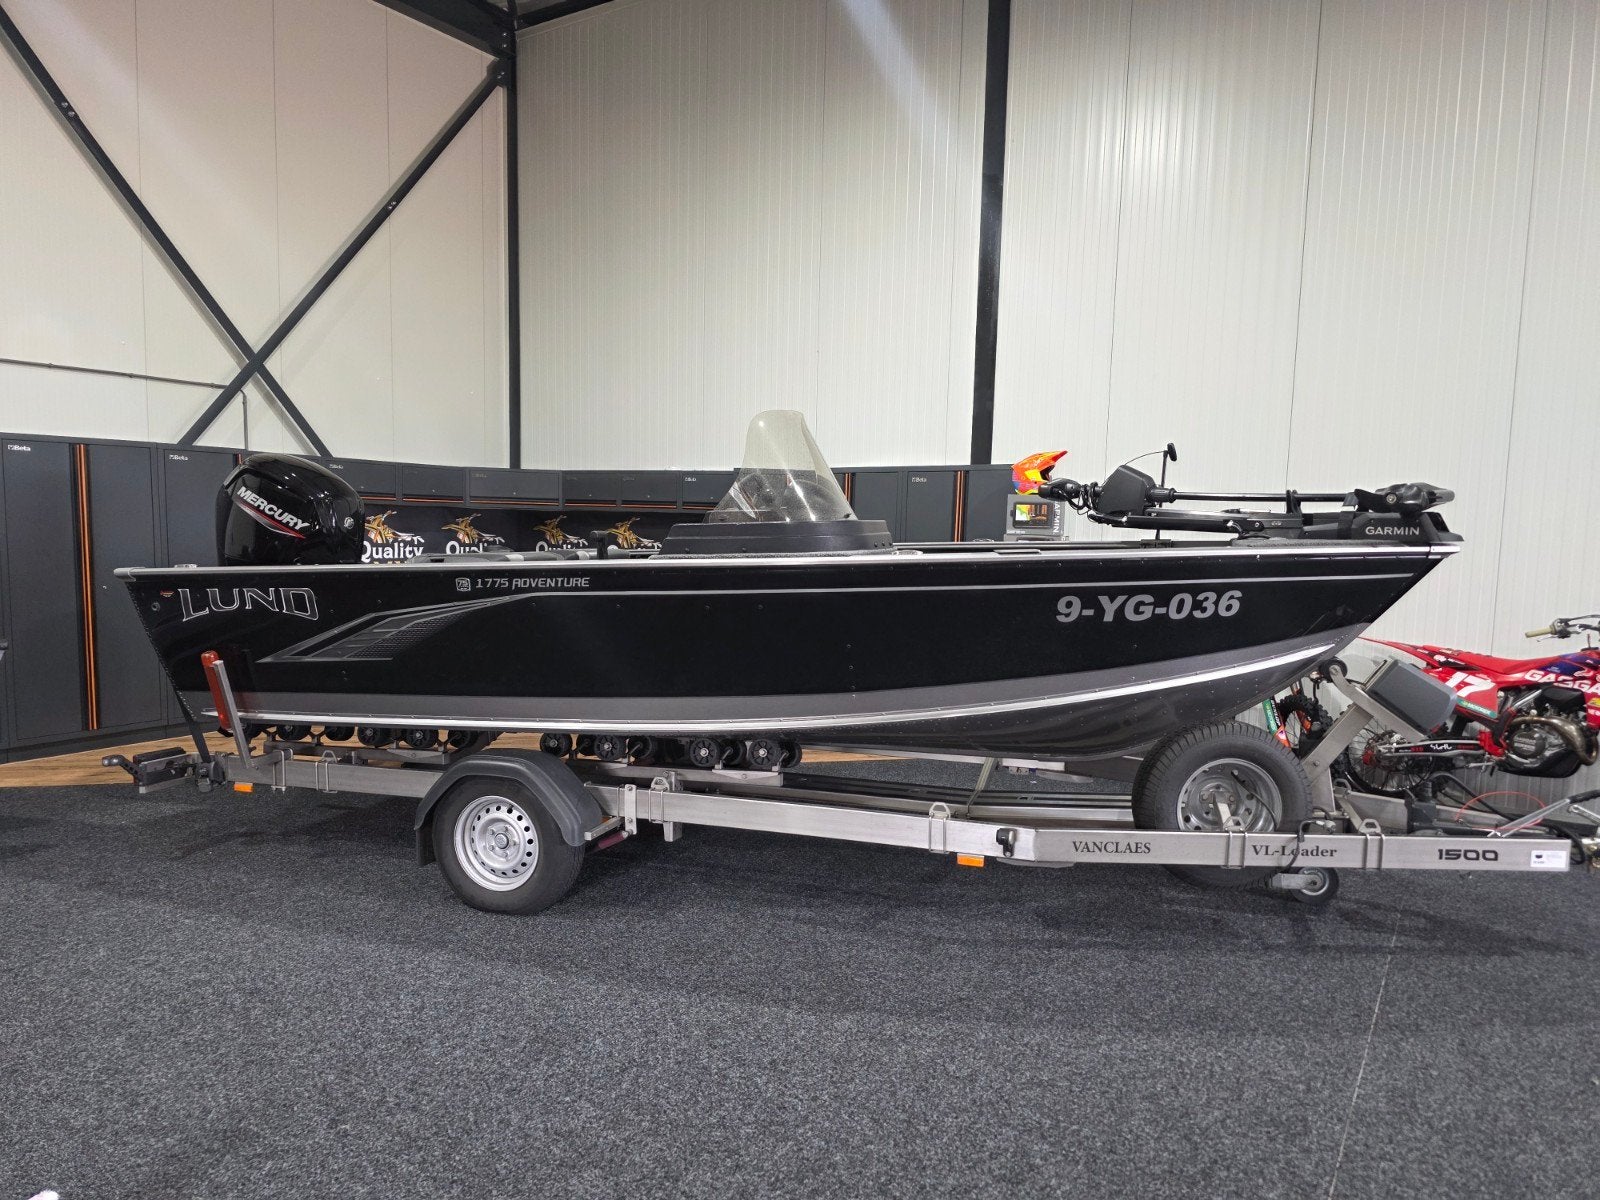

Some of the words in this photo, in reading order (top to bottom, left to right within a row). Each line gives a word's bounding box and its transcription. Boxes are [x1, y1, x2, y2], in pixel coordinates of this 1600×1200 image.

[237, 486, 310, 530] MERCURY
[1053, 501, 1061, 533] ARMIN
[1365, 526, 1420, 536] GARMIN
[476, 578, 509, 588] 1775
[512, 577, 591, 590] ADVENTURE
[178, 588, 319, 622] LUND
[1056, 590, 1243, 622] 9-YG-036
[1445, 671, 1496, 698] 17
[1072, 841, 1151, 854] VANCLAES
[1438, 849, 1499, 861] 1500
